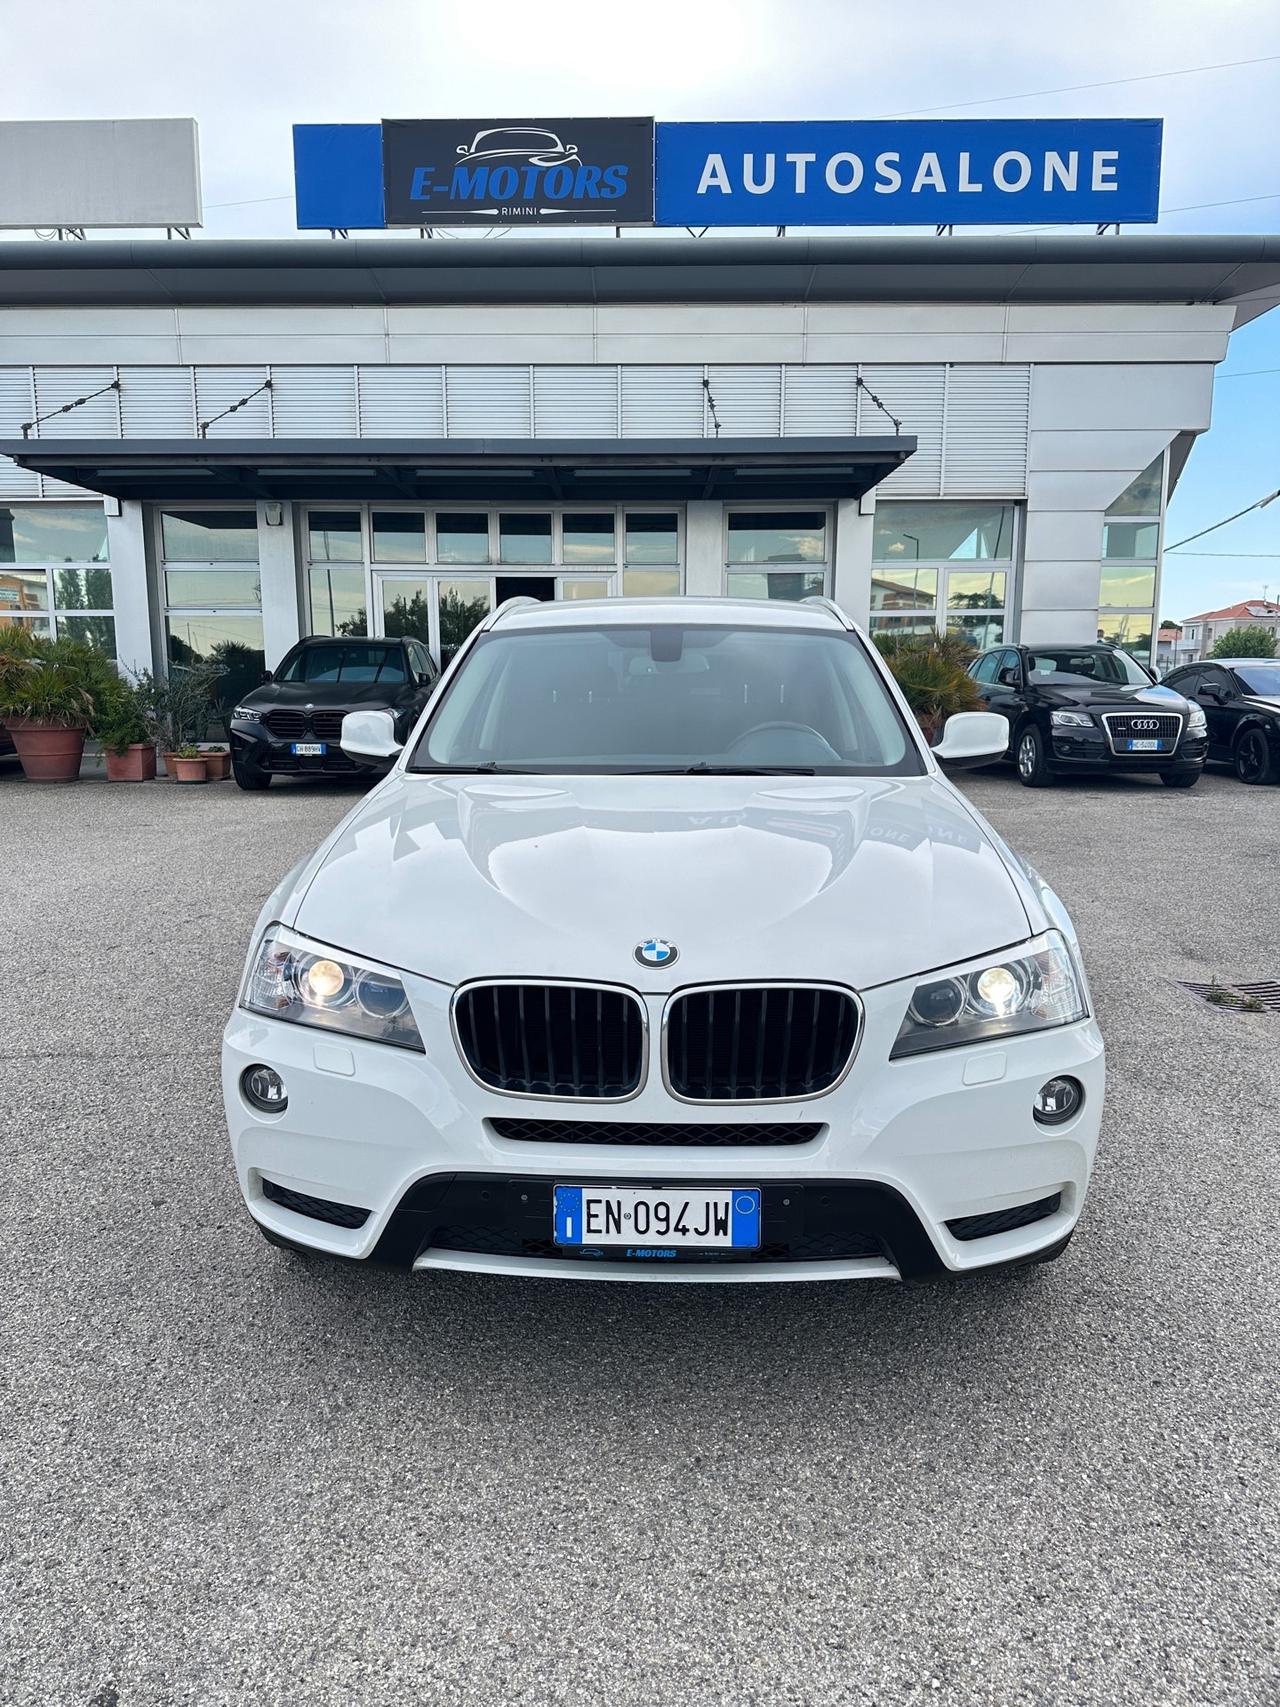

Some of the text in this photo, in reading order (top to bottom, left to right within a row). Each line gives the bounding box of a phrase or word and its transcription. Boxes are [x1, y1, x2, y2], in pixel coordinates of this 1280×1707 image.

[409, 164, 629, 201] E-MOTORS
[696, 150, 1120, 195] AUTOSALONE
[501, 206, 538, 217] RIMINI
[585, 1199, 730, 1236] EN 094JW
[626, 1248, 677, 1258] E-MOTORS
